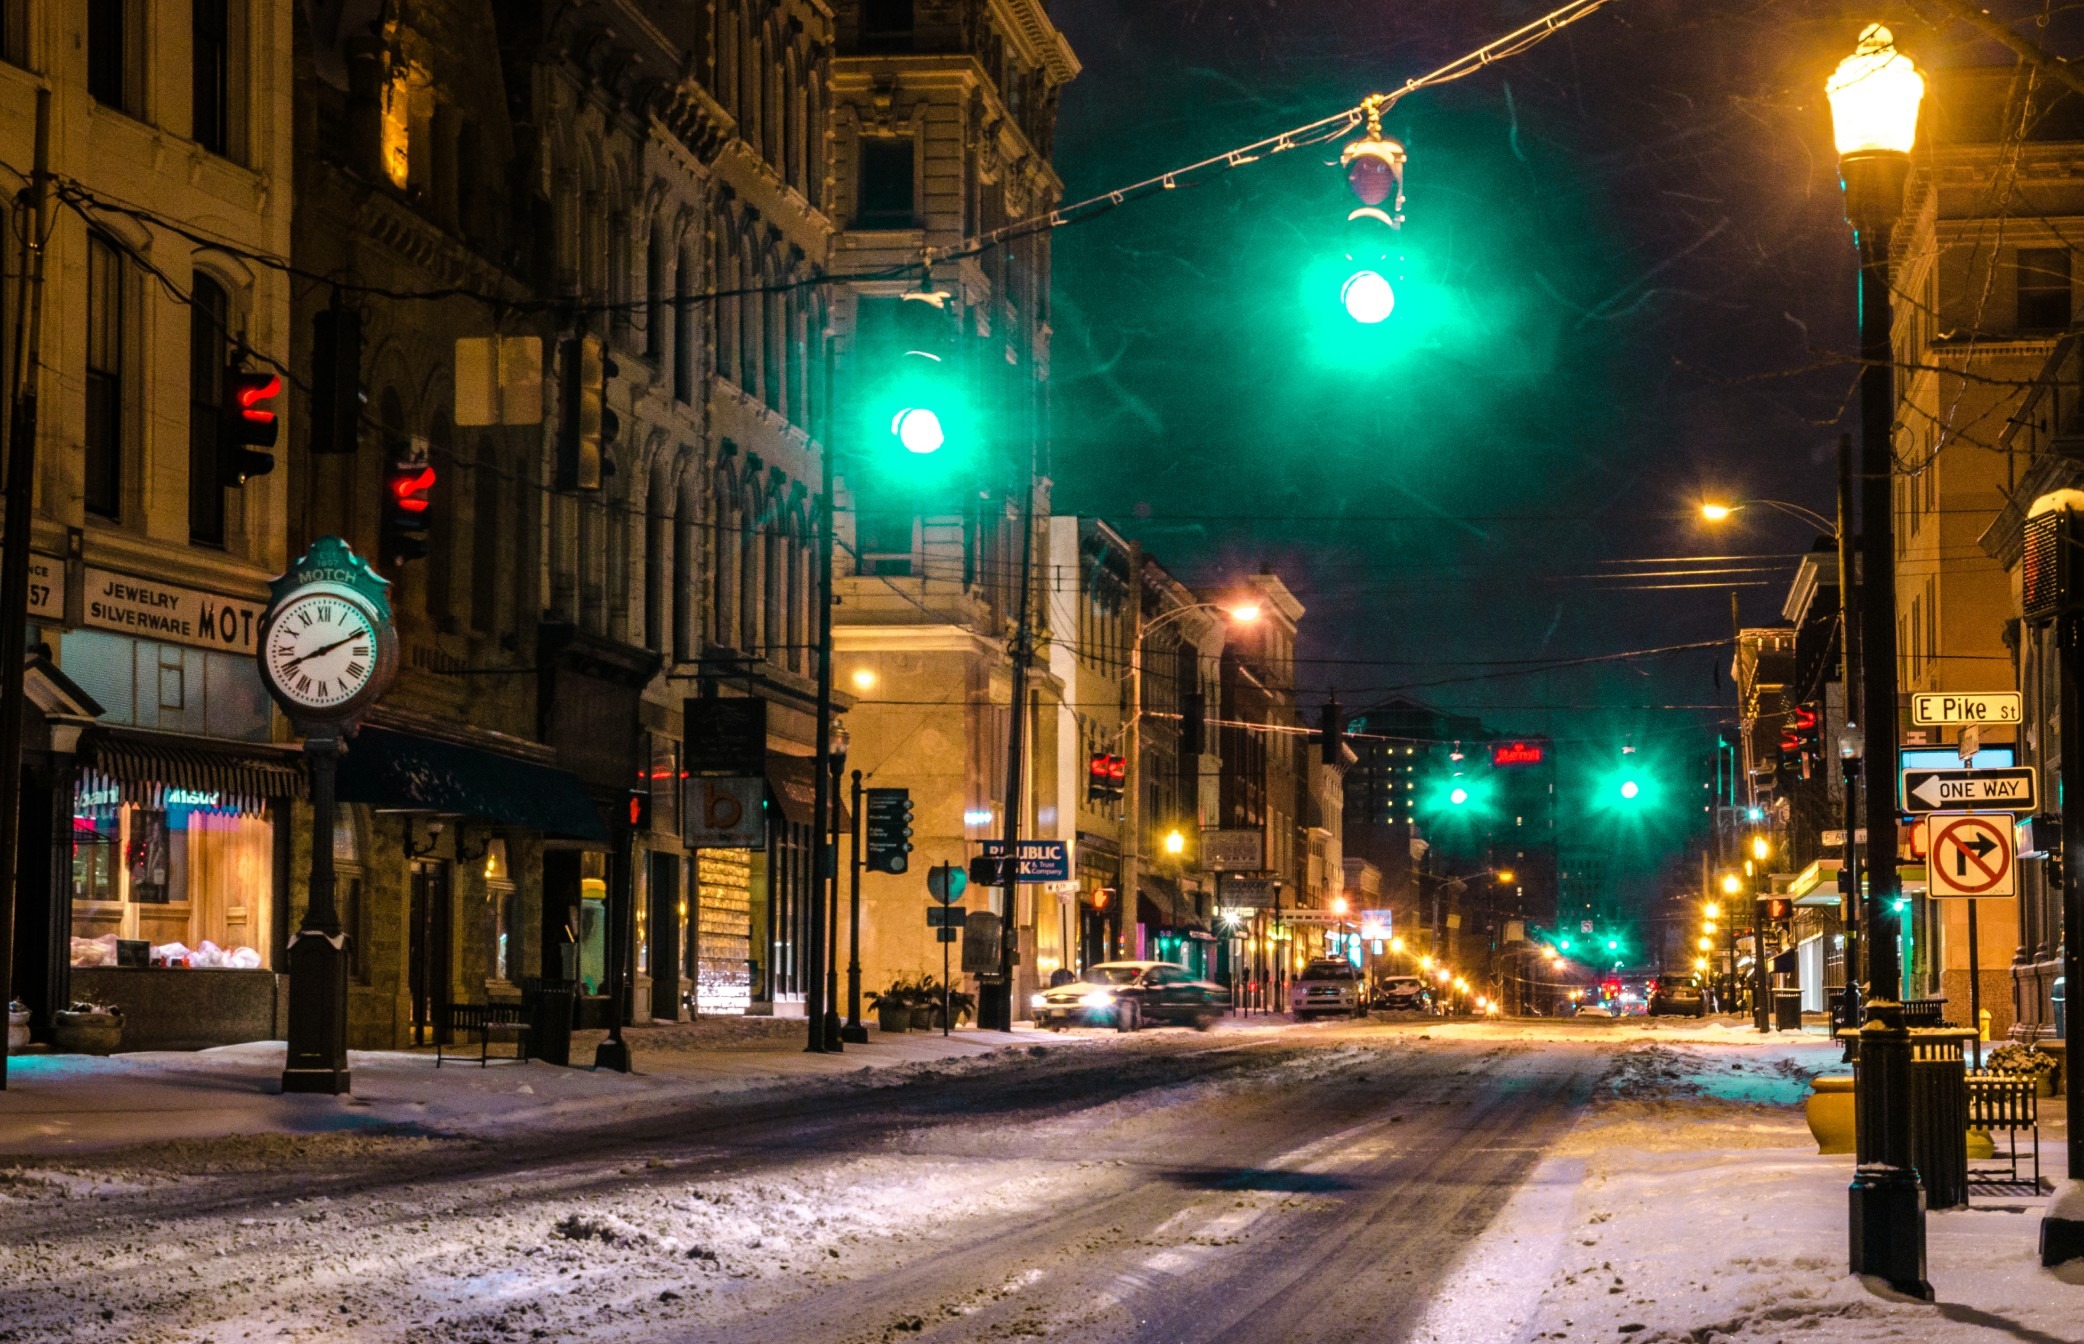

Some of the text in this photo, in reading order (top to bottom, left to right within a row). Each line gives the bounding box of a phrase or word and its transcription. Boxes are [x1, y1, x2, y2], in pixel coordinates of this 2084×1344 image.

[299, 568, 356, 583] MOTCH
[103, 582, 180, 611] JEWELRY
[91, 601, 191, 637] SILVERWARE
[298, 610, 313, 628] XI
[317, 606, 331, 623] XII
[198, 600, 263, 647] MOT
[283, 626, 300, 640] X
[279, 645, 295, 657] IX
[352, 646, 369, 656] III
[1920, 698, 2016, 720] E Pike St
[1940, 781, 2020, 799] ONE WAY
[1031, 868, 1063, 876] Company
